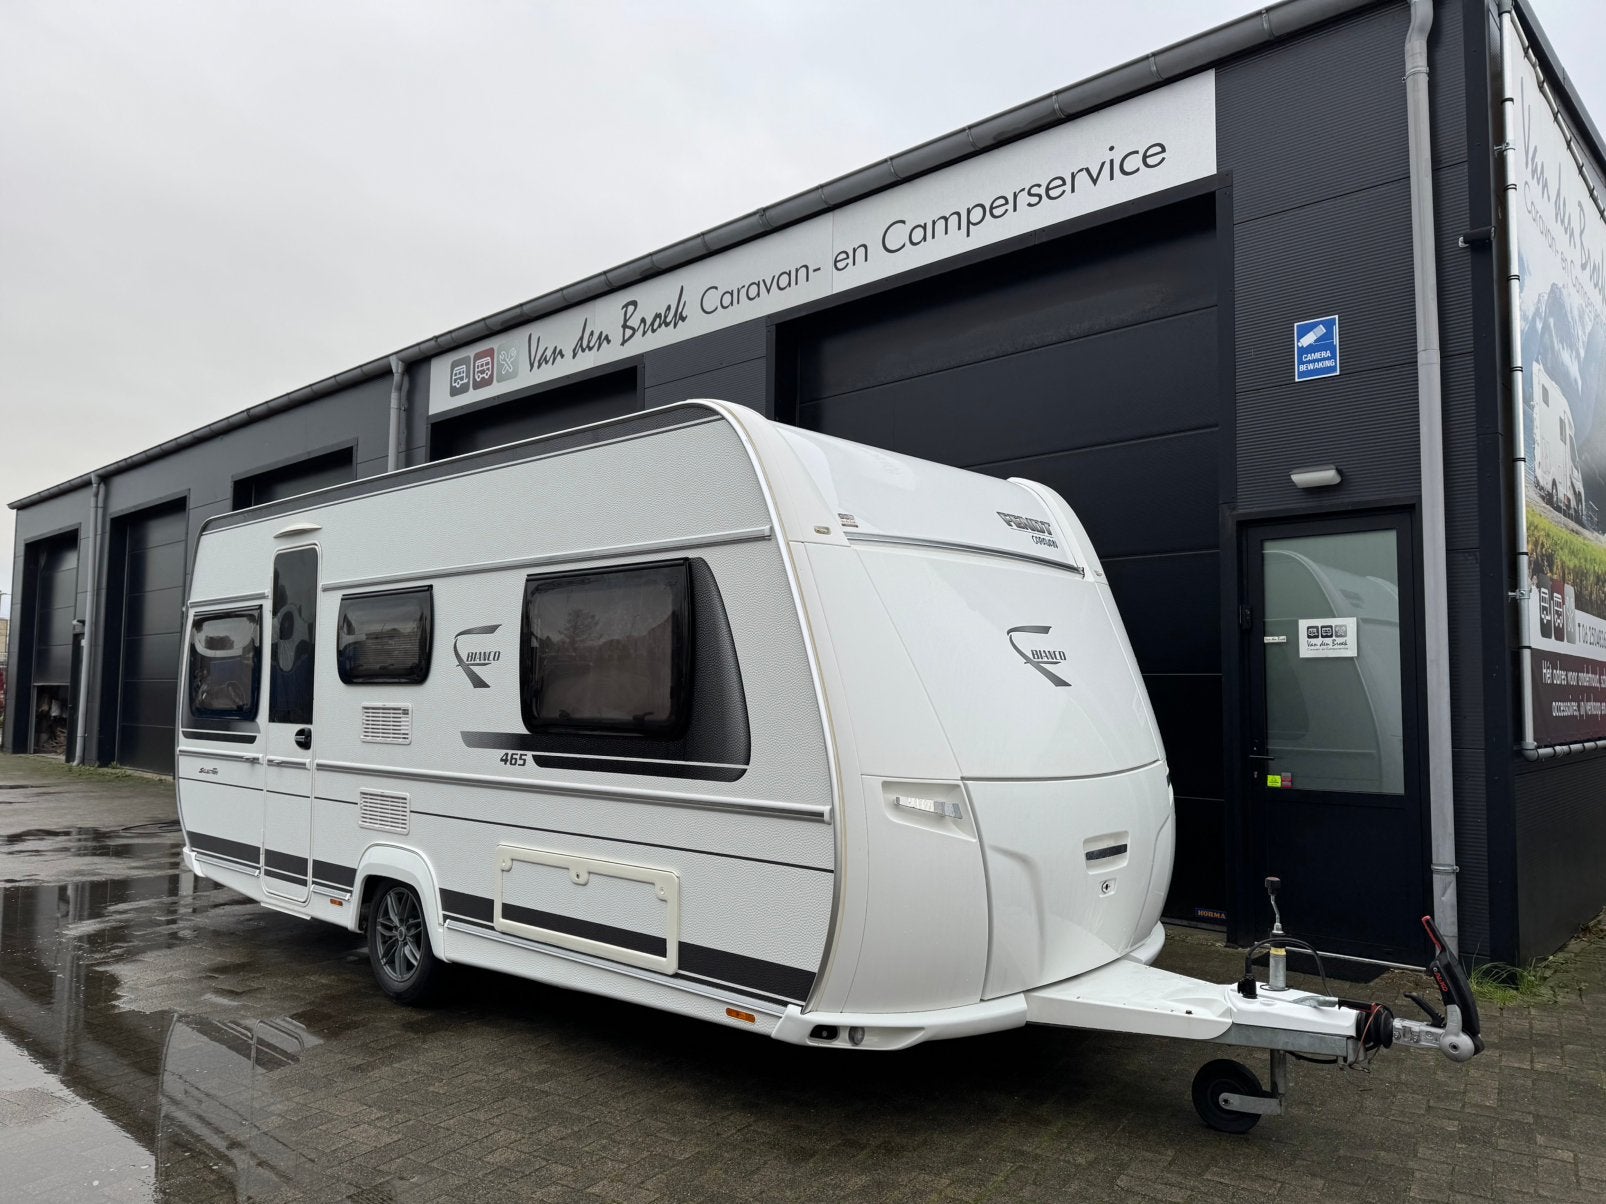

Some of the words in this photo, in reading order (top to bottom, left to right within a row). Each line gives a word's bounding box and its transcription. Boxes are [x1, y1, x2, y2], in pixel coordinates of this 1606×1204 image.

[1520, 76, 1550, 203] Van
[1554, 162, 1576, 249] den
[528, 332, 565, 372] Van
[572, 320, 612, 361] den
[620, 286, 688, 347] Broek
[700, 265, 822, 315] Caravan-
[833, 242, 868, 272] en
[881, 141, 1167, 255] Camperservice
[1302, 350, 1331, 361] CAMERA
[1299, 359, 1335, 372] BEWAKING
[466, 650, 501, 662] BIANCO
[1031, 649, 1067, 661] BIANCO
[500, 752, 527, 767] 465
